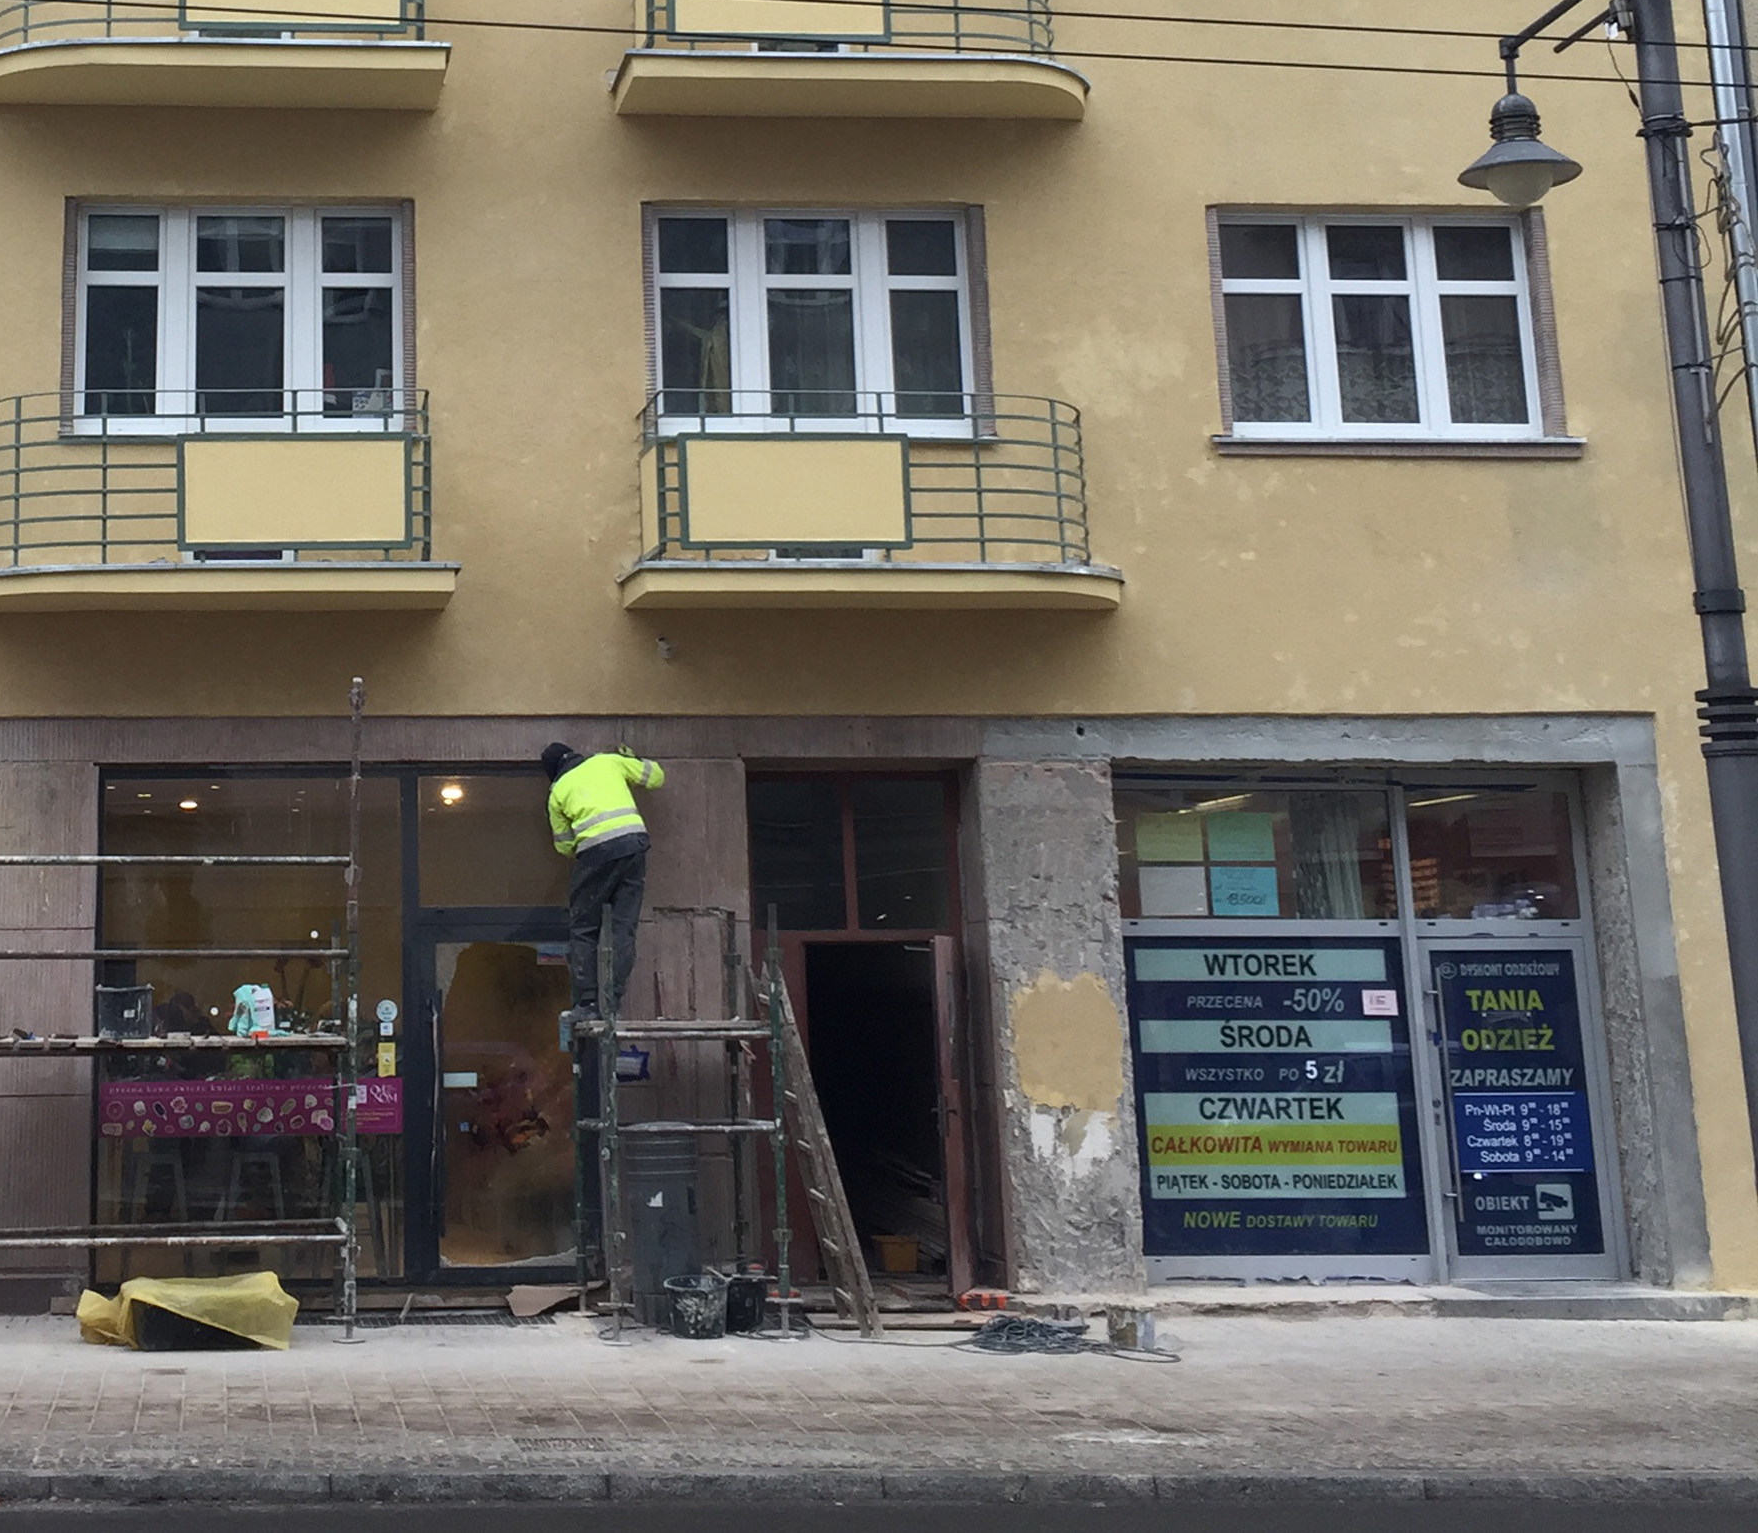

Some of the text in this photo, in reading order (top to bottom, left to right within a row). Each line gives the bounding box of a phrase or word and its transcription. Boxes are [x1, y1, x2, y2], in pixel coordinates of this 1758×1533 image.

[1204, 954, 1317, 975] WTOREK
[1187, 988, 1345, 1012] PRZECENA -50%
[1465, 989, 1545, 1011] TANIA
[1220, 1020, 1313, 1048] ŚRODA
[1461, 1023, 1555, 1051] ODZIEŻ
[1185, 1060, 1345, 1084] WSZYSTKO PO 5 zł
[1450, 1068, 1574, 1087] ZAPRASZAMY
[1199, 1097, 1345, 1120] CZWARTEK
[1483, 1117, 1517, 1132] Środa
[1151, 1135, 1398, 1155] CAŁKOWITA WYMIANA TOWARU
[1466, 1135, 1519, 1148] Czwartek
[1481, 1151, 1520, 1163] Sobota
[1156, 1174, 1209, 1193] PIĄTEK
[1221, 1173, 1281, 1189] SOBOTA
[1293, 1173, 1398, 1189] PONIEDZIAŁEK
[1475, 1196, 1530, 1211] OBIEKT
[1184, 1211, 1378, 1228] NOWE DOSTAWY TOWARU
[1476, 1224, 1579, 1235] MONITOROWANY
[1485, 1236, 1572, 1247] CAŁODOBOWO
